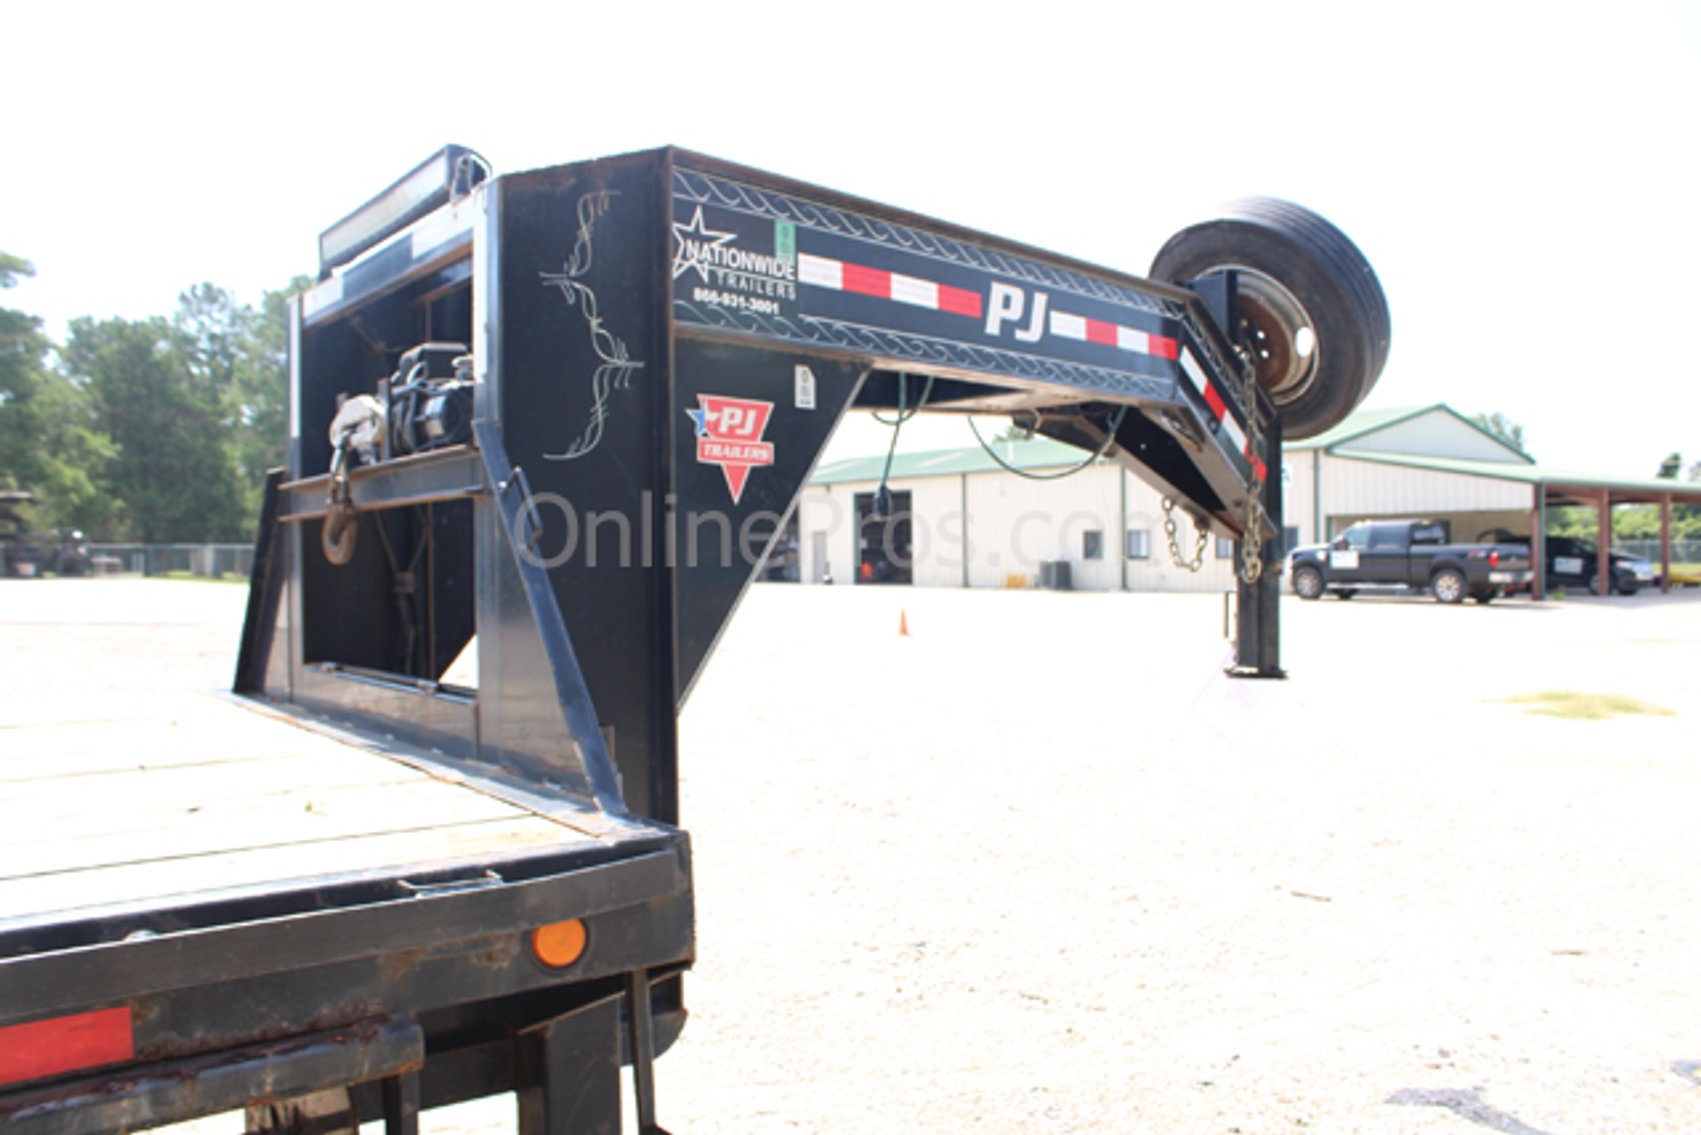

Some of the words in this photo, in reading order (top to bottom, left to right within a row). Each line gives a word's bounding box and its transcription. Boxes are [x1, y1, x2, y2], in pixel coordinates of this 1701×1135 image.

[686, 239, 796, 281] NATIONWIDE
[716, 270, 797, 302] TRAILERS
[985, 280, 1048, 343] PJ
[719, 406, 757, 436] PJ
[704, 443, 769, 460] TRAILERS
